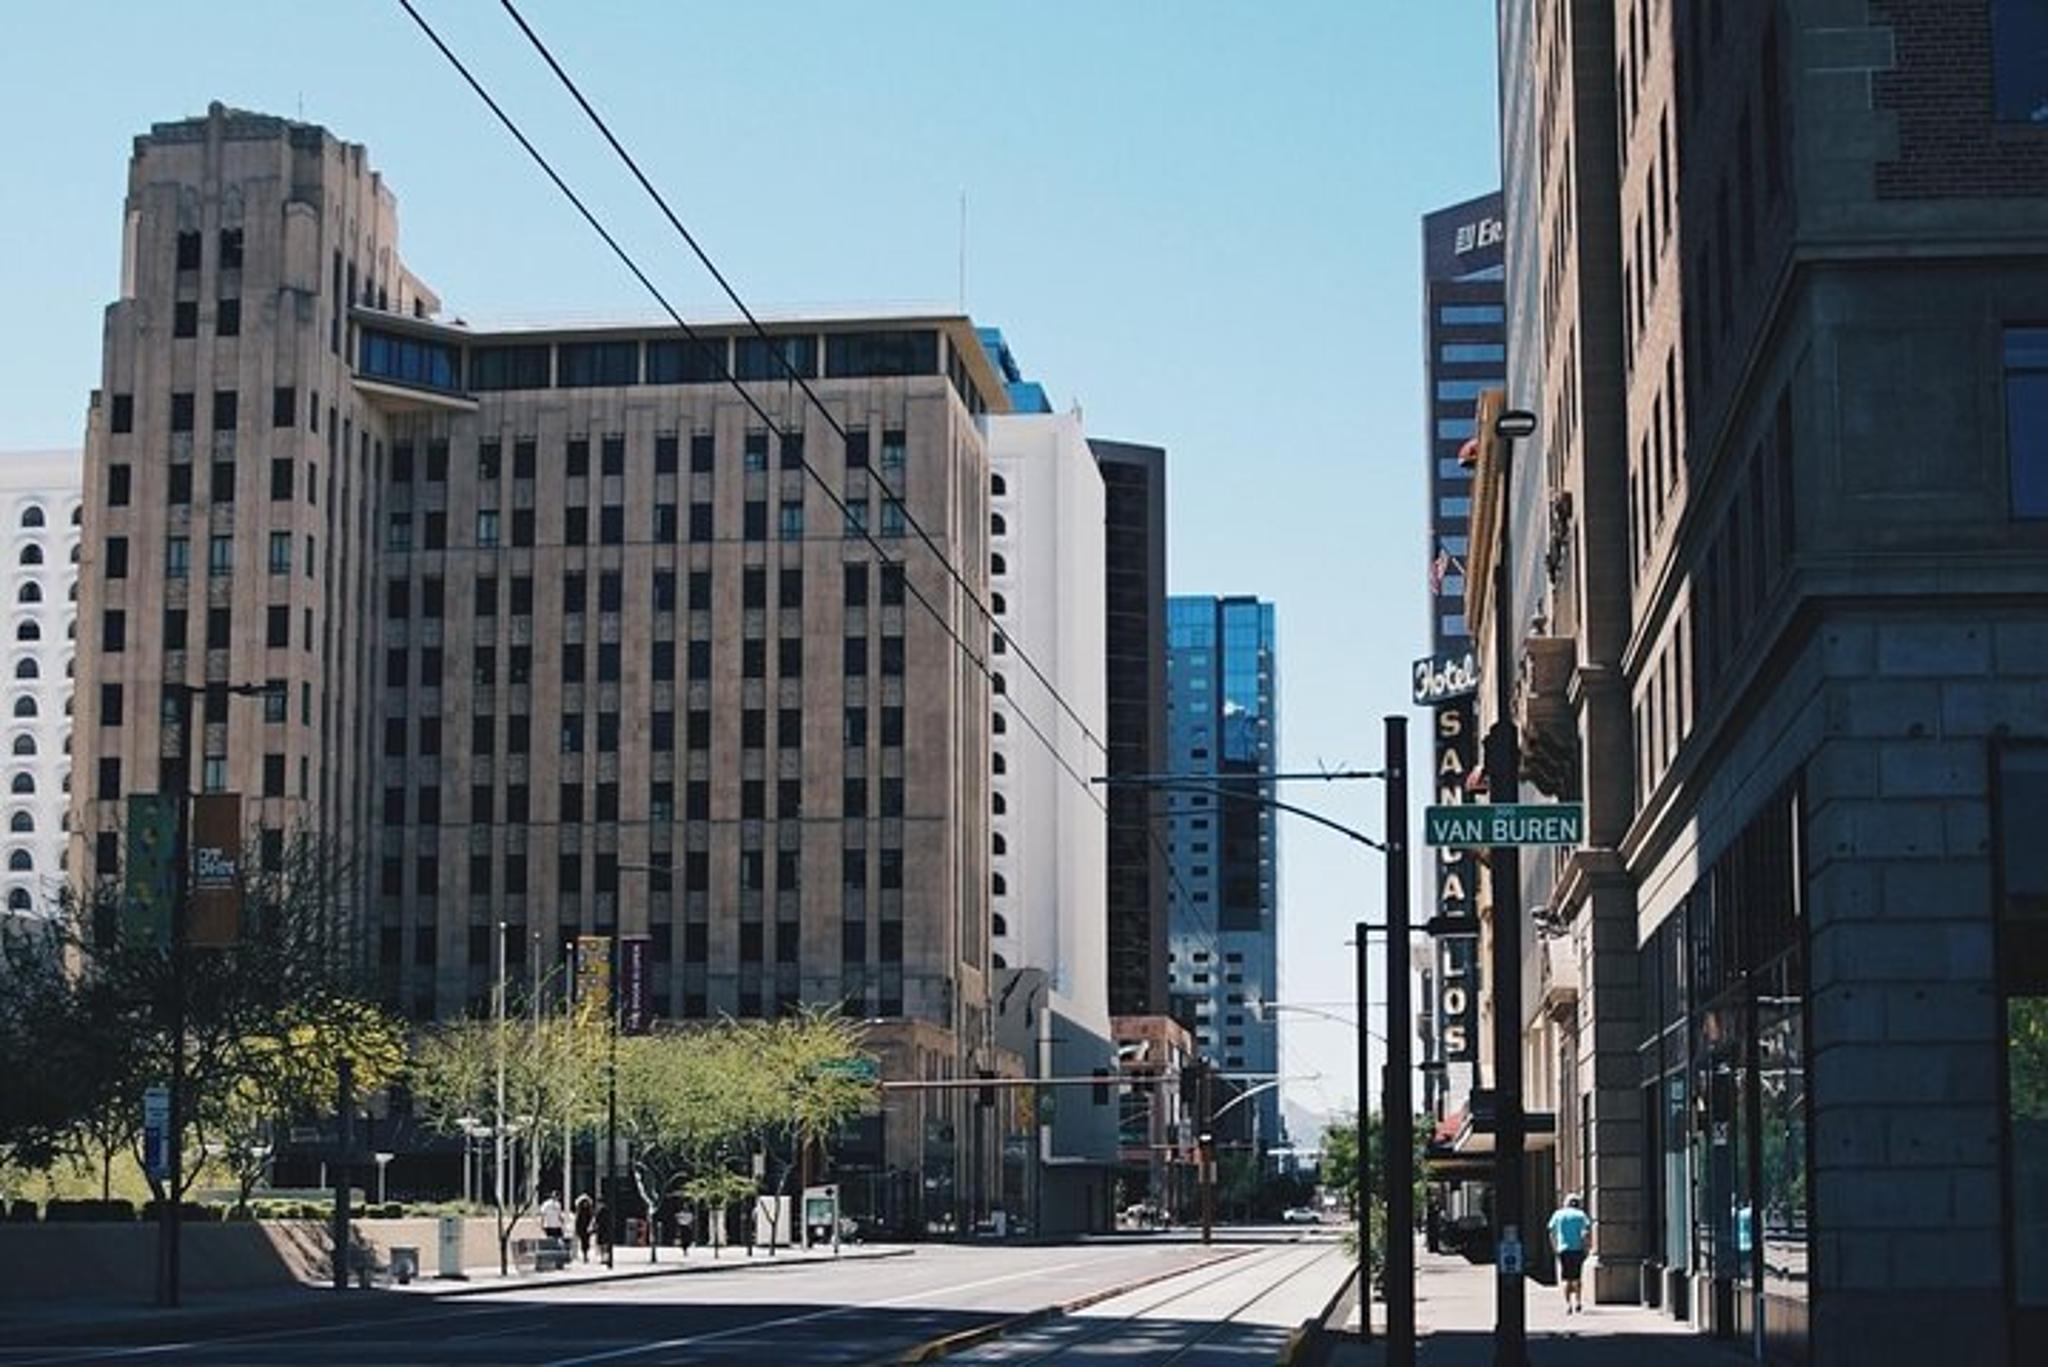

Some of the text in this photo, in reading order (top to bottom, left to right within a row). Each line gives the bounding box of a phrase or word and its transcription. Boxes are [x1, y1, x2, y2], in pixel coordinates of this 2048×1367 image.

[1415, 653, 1477, 700] Hotel
[1433, 817, 1577, 842] VAN BUREN
[1439, 710, 1467, 1053] SAN CALOS
